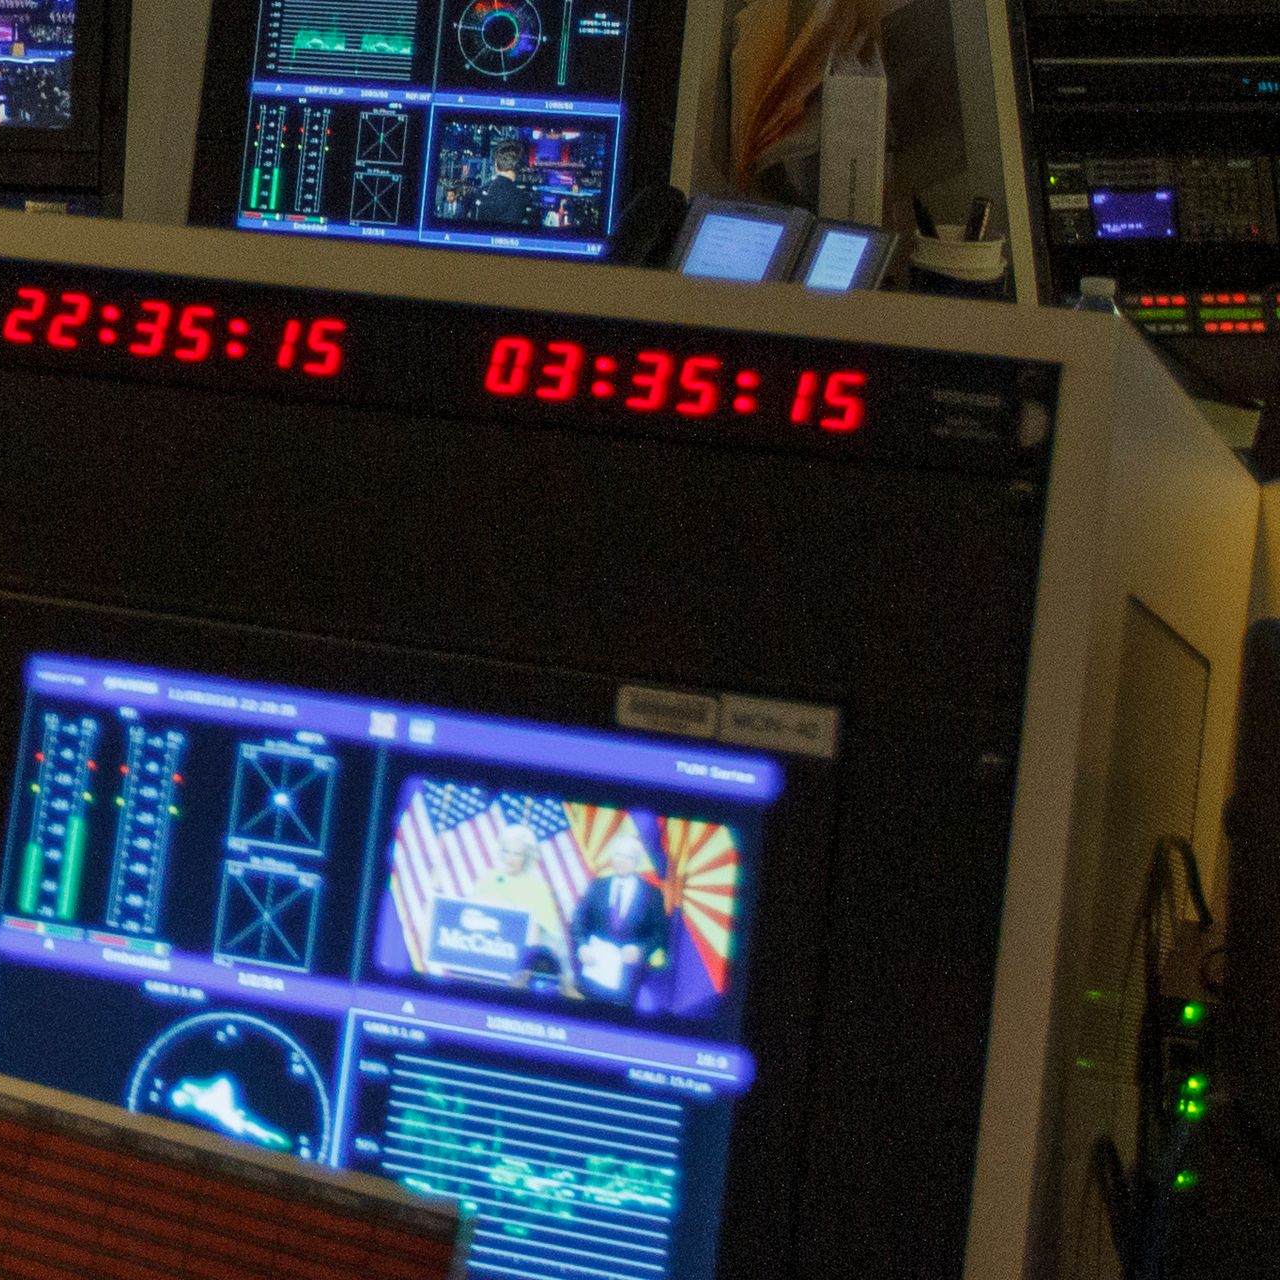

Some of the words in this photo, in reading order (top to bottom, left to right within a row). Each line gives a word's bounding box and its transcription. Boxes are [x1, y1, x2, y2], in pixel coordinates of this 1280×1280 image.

[2, 287, 347, 378] 22:35:15
[484, 336, 867, 433] 03:35:15
[441, 928, 517, 960] McCain
